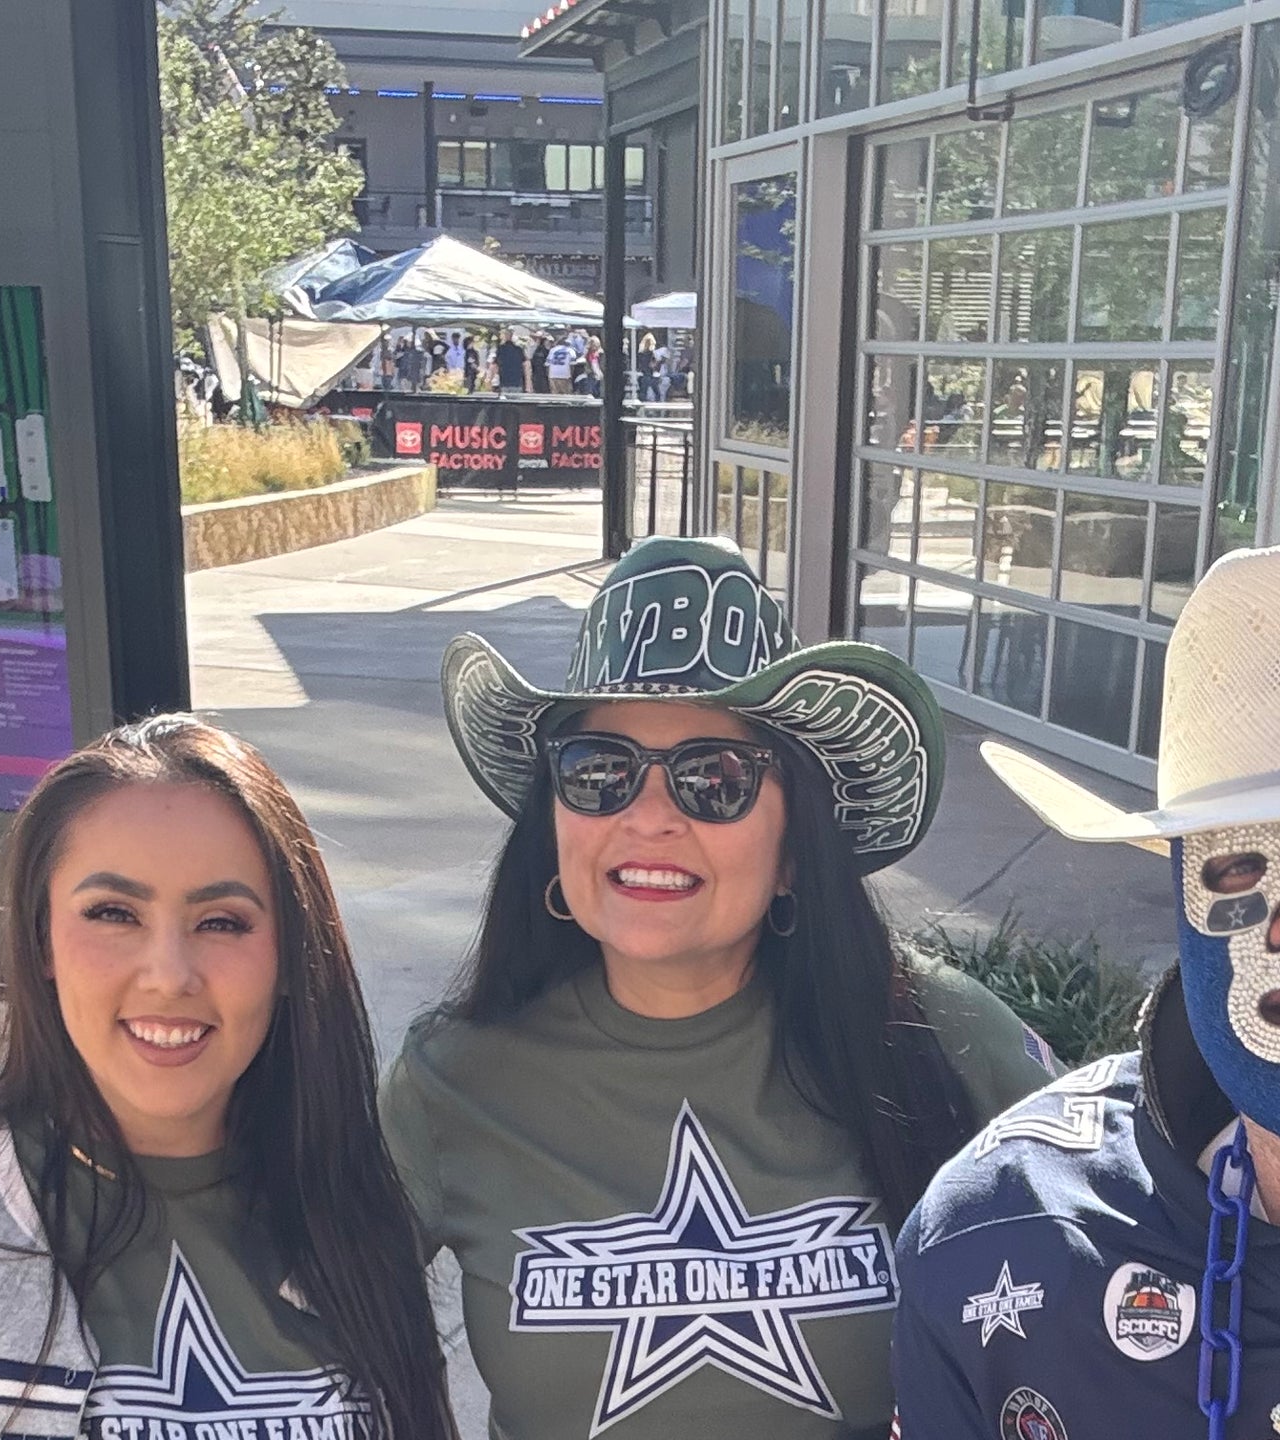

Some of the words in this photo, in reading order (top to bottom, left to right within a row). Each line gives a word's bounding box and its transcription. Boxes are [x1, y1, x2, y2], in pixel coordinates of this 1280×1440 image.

[429, 425, 507, 449] MUSIC
[551, 425, 602, 448] MUS
[429, 452, 507, 470] FACTORY
[551, 452, 604, 469] FACTO
[523, 1267, 585, 1307] ONE
[591, 1261, 678, 1307] STAR
[685, 1260, 750, 1301] ONE
[756, 1244, 880, 1298] FAMILY
[1117, 1318, 1180, 1341] SCDCFC
